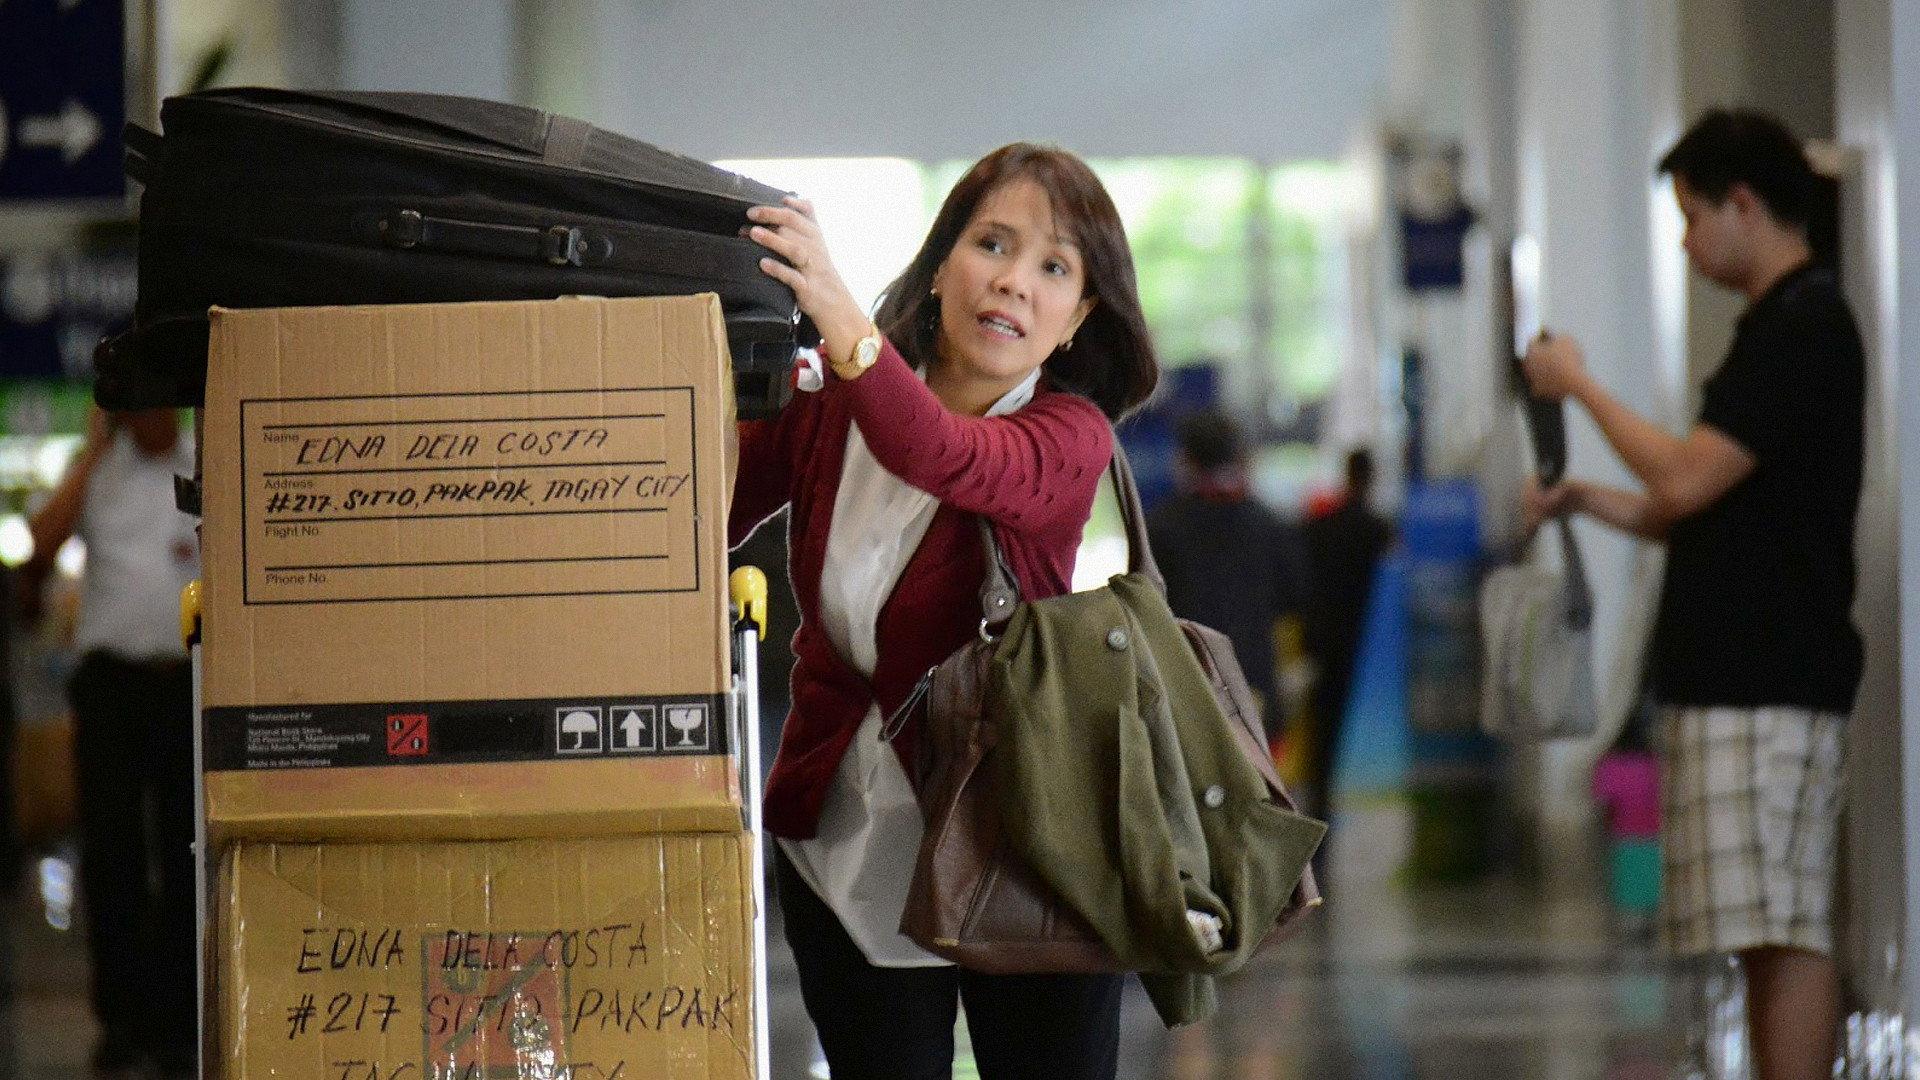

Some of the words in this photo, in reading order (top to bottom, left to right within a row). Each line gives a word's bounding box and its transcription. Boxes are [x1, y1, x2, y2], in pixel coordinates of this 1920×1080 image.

[263, 432, 300, 443] Name
[296, 435, 386, 465] EDNA
[405, 432, 480, 461] DELA
[496, 428, 609, 455] COSTA
[263, 478, 314, 490] Address
[543, 474, 631, 502] TAGAY
[635, 473, 690, 498] CITY
[264, 526, 298, 539] Flight
[265, 573, 305, 586] Phone
[296, 928, 404, 974] EDNA
[440, 929, 519, 970] DELA
[542, 920, 648, 969] COSTA
[286, 991, 401, 1040] #217
[571, 985, 739, 1034] PAKPAK
